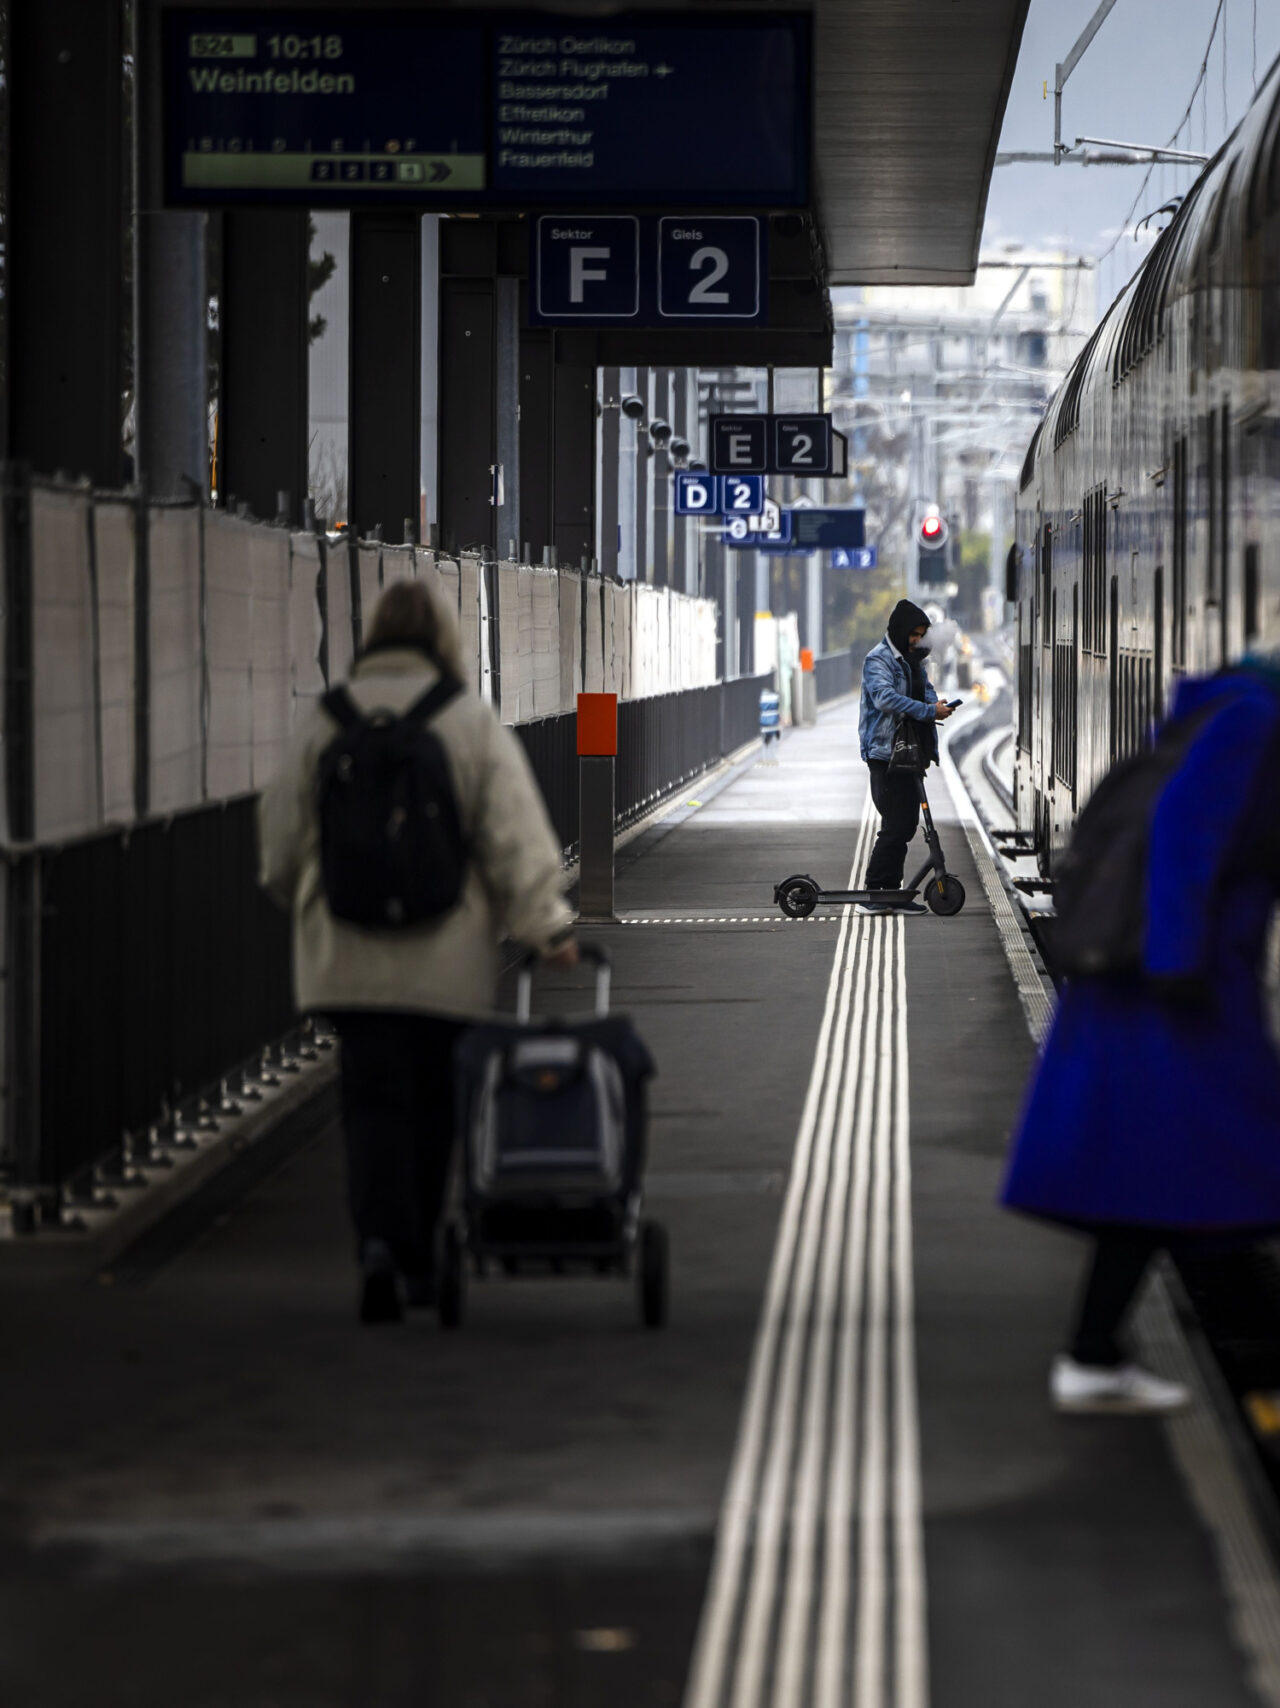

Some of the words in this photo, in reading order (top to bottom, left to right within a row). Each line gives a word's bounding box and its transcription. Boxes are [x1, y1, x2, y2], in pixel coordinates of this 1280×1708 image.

[193, 36, 234, 55] S24
[267, 34, 343, 59] 10:18
[501, 37, 556, 53] Zürich
[561, 37, 635, 53] Oerlikon
[501, 59, 556, 76] Zürich
[562, 59, 648, 80] Flughafen
[190, 68, 354, 93] Weinfelden
[500, 81, 608, 99] Bassersdorf
[501, 105, 584, 121] Effretikon
[500, 128, 593, 144] Winterthur
[501, 149, 593, 167] Frauenfeld
[551, 229, 593, 240] Sektor
[671, 229, 703, 240] Gleis
[570, 247, 610, 303] F
[688, 246, 729, 303] 2
[729, 434, 752, 464] E
[791, 434, 813, 464] 2
[686, 484, 708, 508] D
[734, 484, 751, 508] 2
[766, 510, 775, 529] 5
